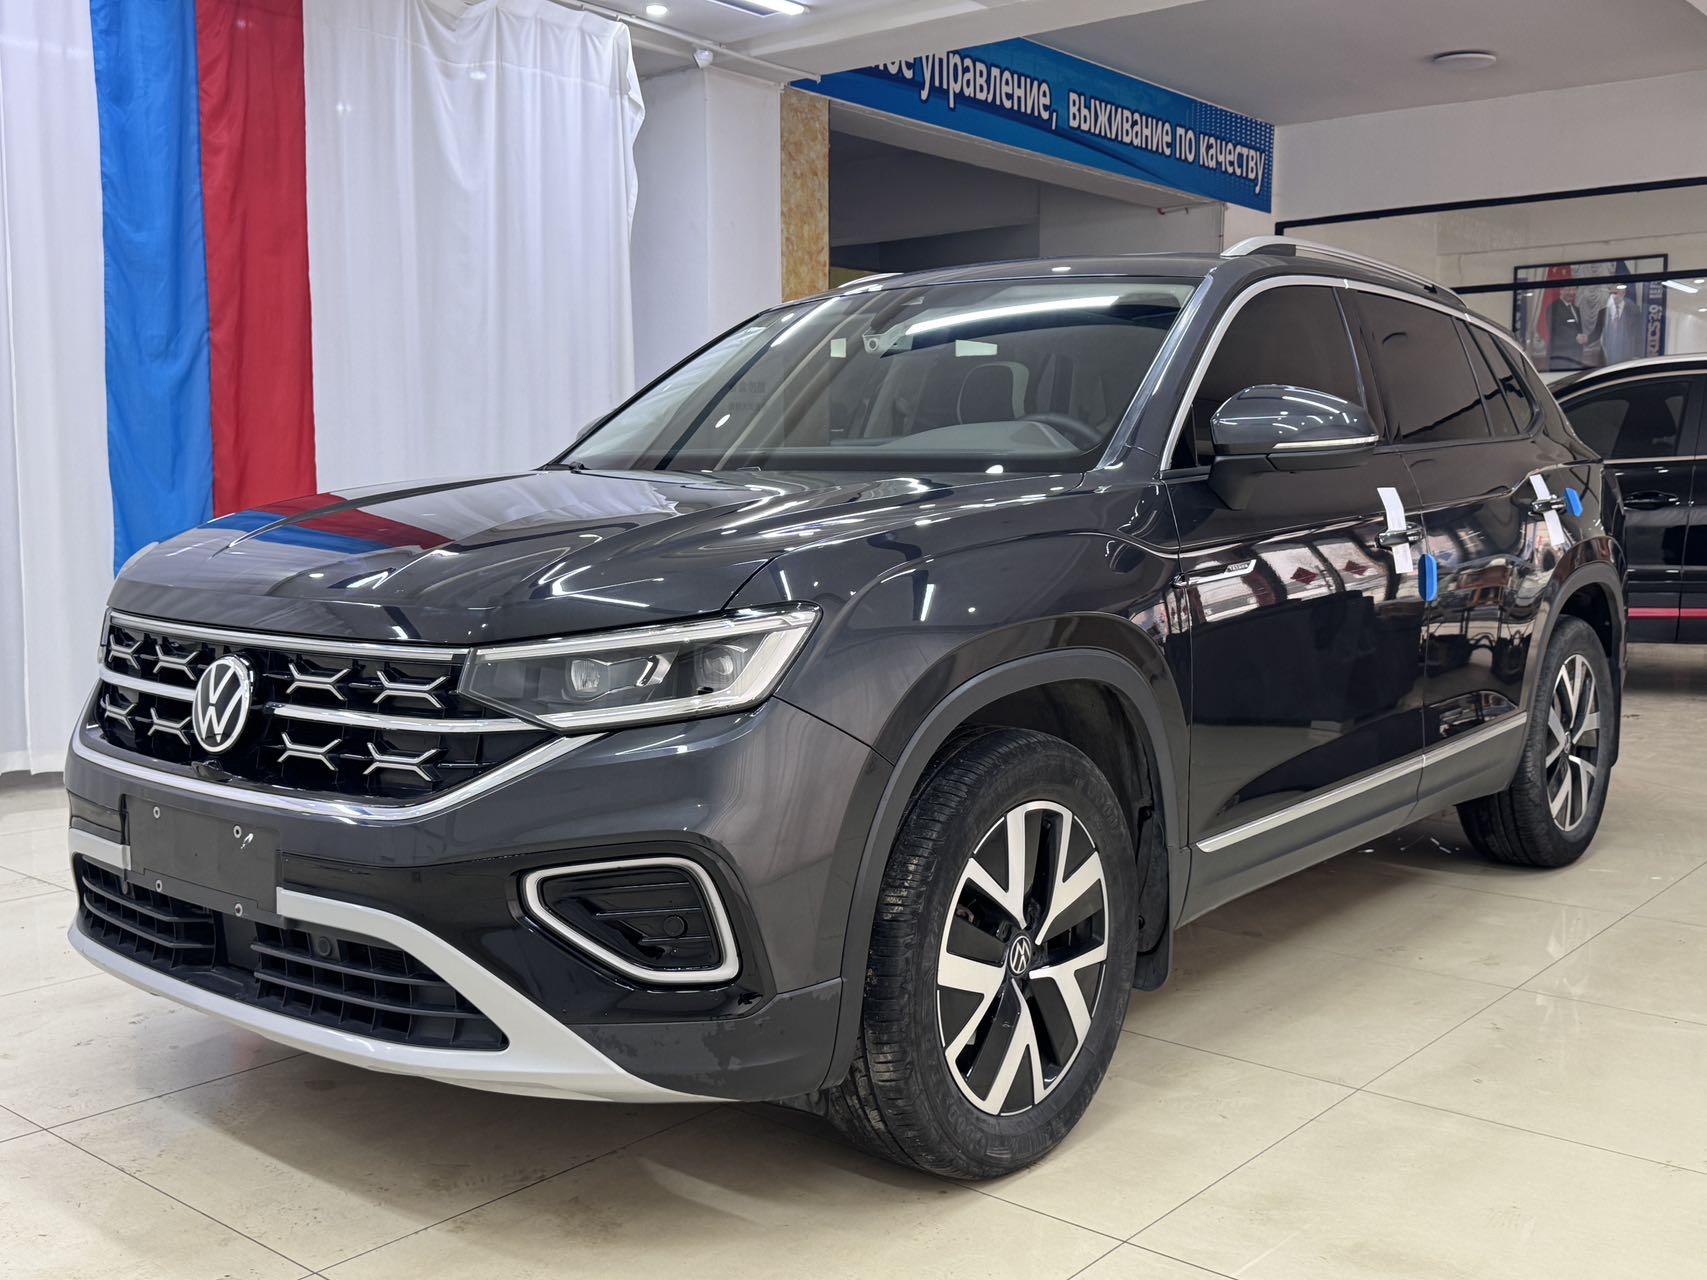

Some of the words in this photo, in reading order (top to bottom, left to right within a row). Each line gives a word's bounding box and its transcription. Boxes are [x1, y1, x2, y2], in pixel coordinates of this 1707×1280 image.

[920, 53, 1057, 131] управление,
[1068, 91, 1173, 157] выживание
[1175, 126, 1196, 163] по
[1199, 133, 1266, 194] качеству
[195, 657, 247, 749] VW
